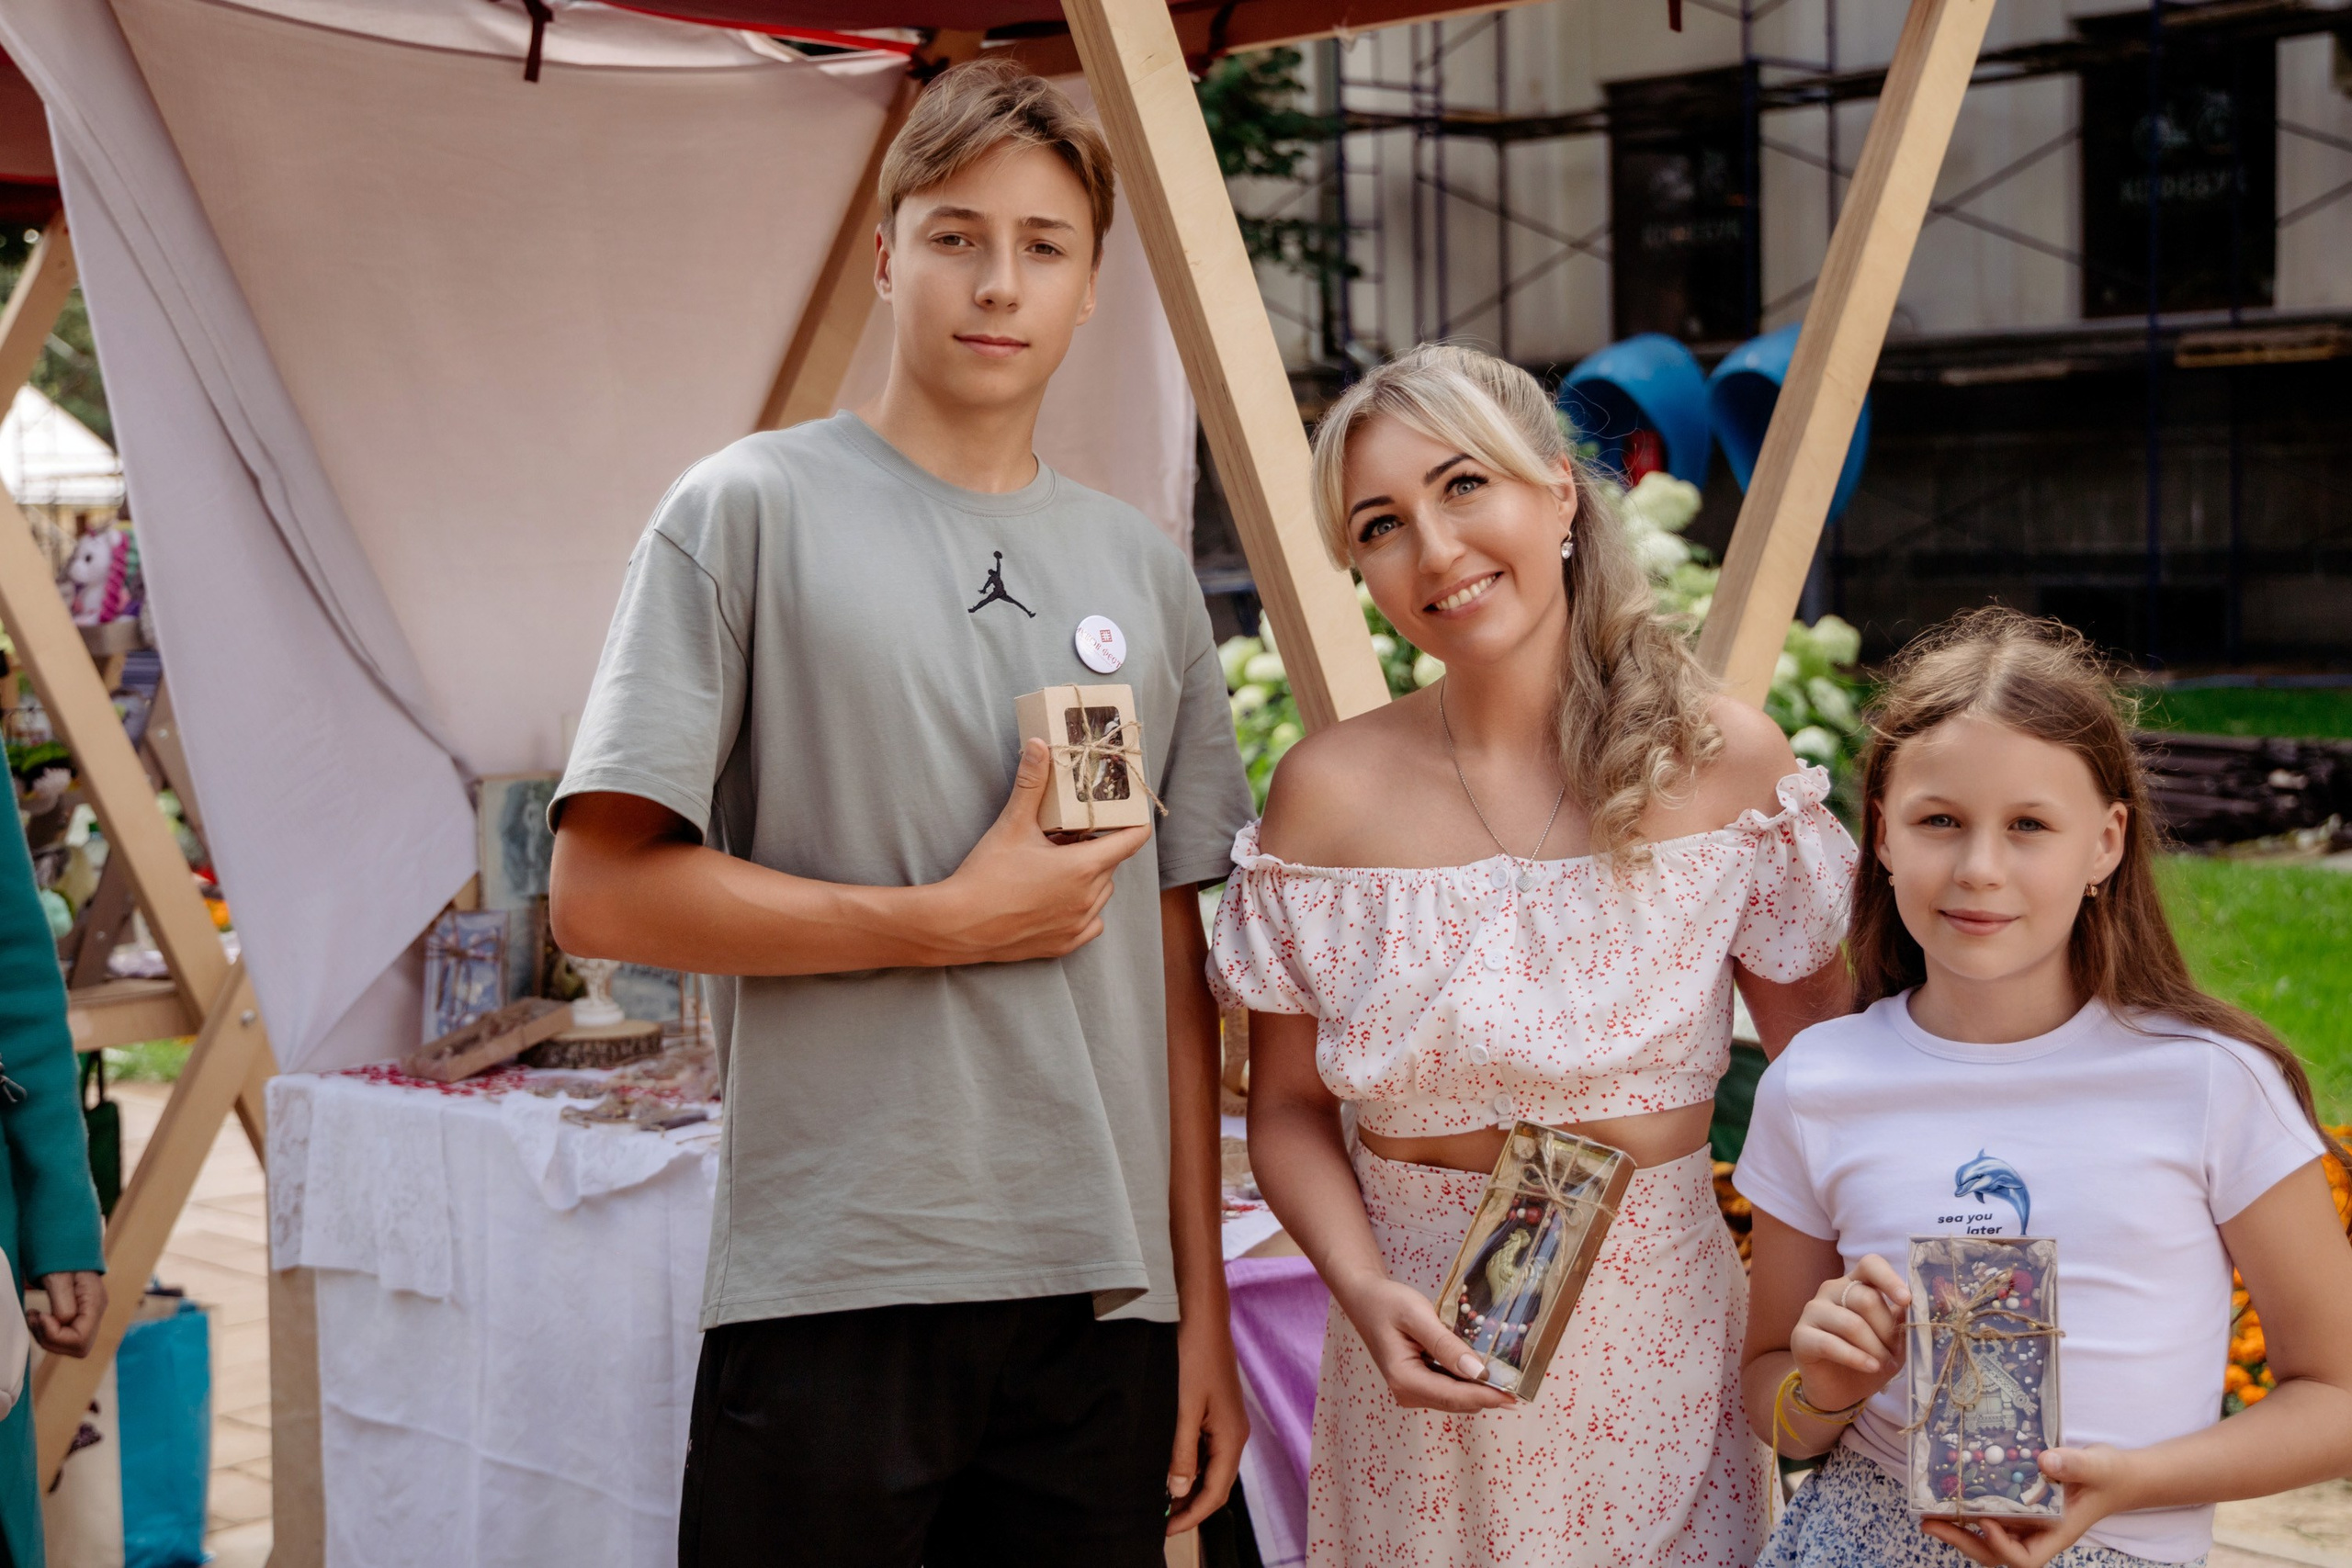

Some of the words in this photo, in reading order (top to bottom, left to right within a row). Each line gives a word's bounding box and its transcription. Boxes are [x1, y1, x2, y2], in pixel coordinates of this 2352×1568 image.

[1938, 1215, 1963, 1224] sea
[1966, 1213, 1993, 1224] you
[1966, 1226, 2002, 1235] later
